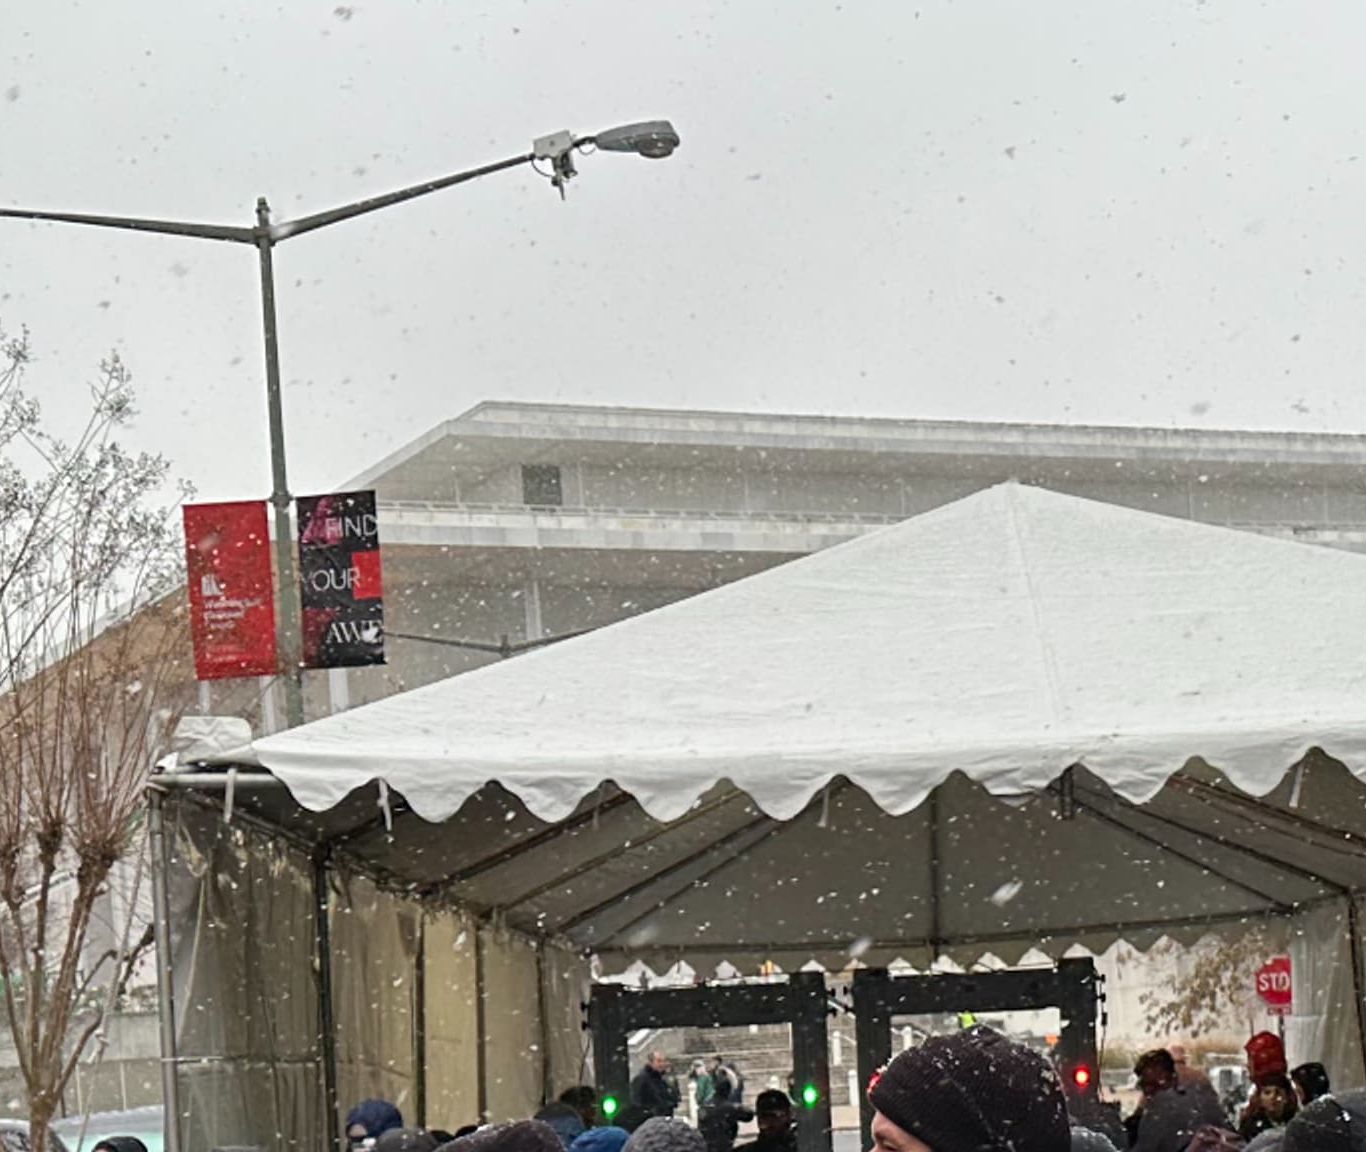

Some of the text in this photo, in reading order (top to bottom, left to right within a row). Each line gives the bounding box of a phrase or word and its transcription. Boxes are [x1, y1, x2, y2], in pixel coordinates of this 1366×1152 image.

[325, 513, 378, 539] FIND
[325, 620, 383, 645] AWE
[1258, 971, 1291, 992] STO
